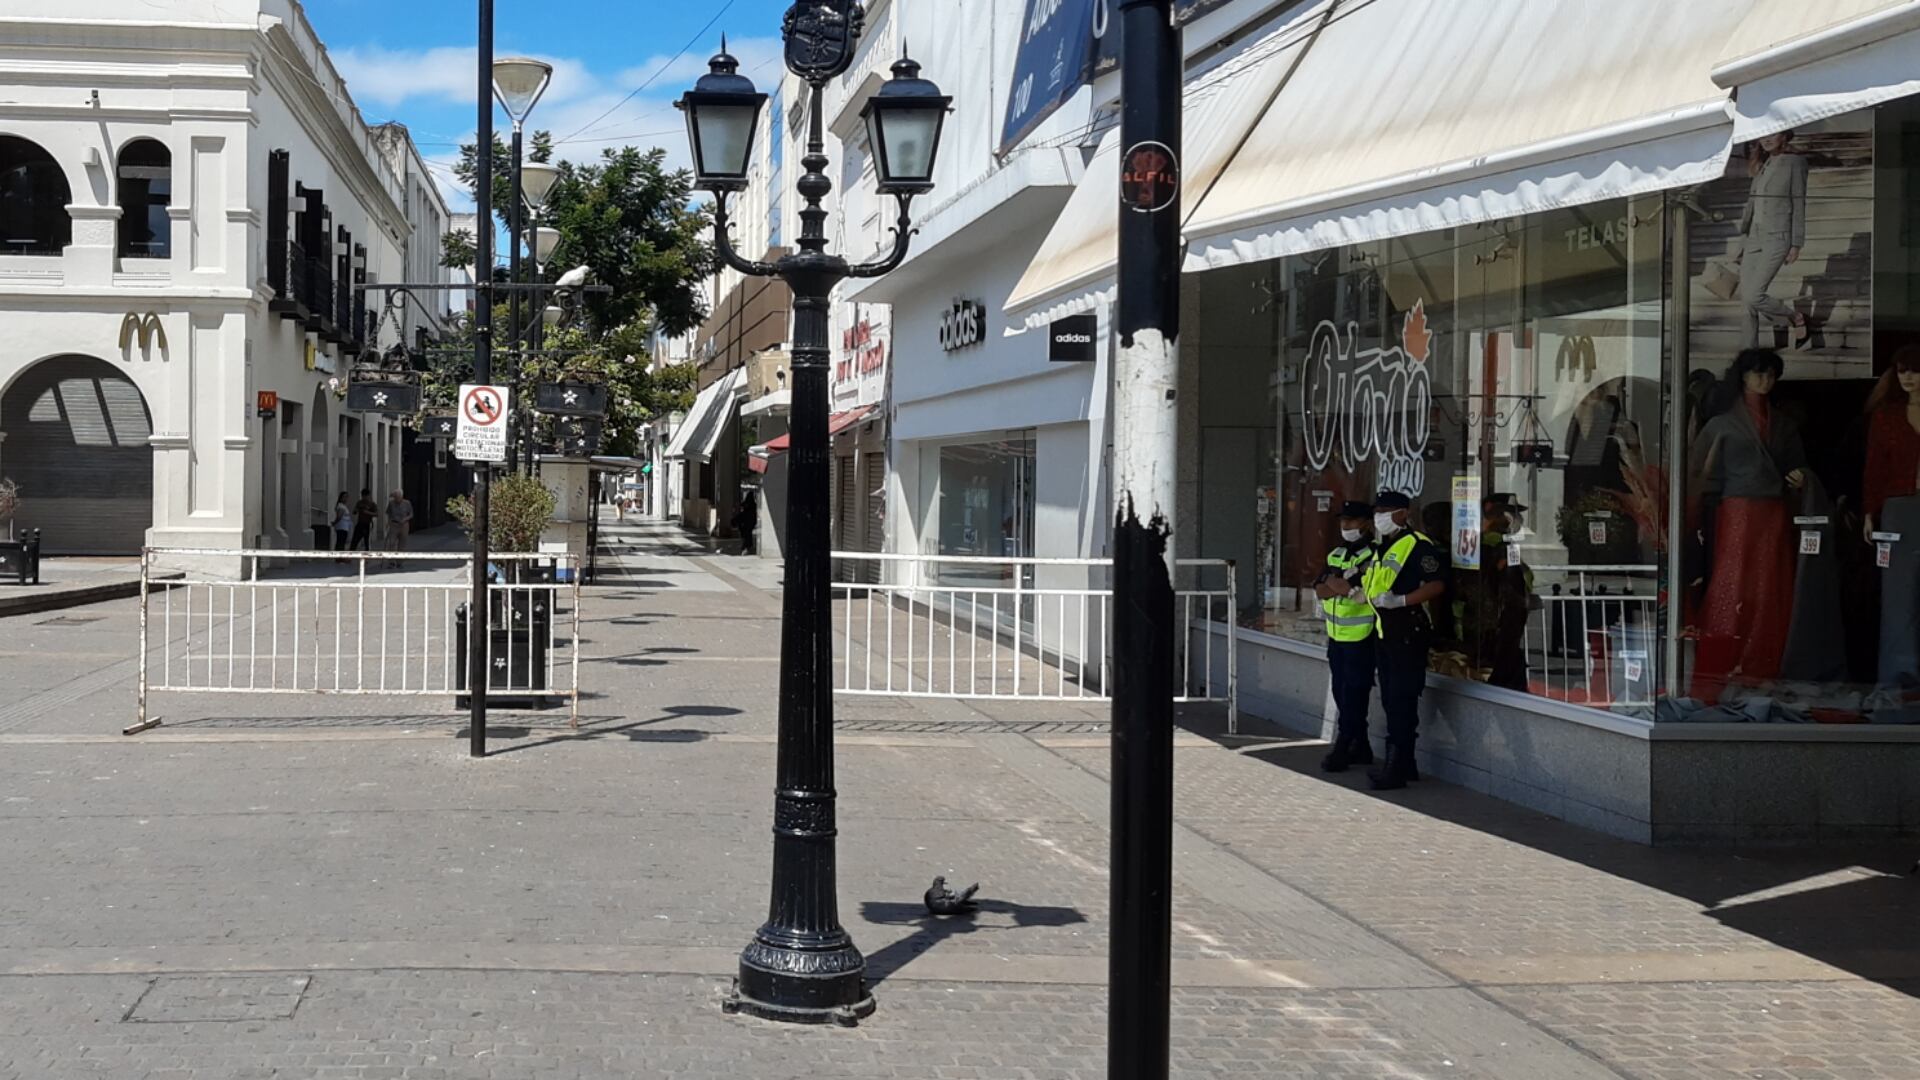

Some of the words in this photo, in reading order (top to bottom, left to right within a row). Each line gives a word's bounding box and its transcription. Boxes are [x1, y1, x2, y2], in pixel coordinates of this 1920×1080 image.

[1565, 216, 1628, 252] TELAS
[939, 300, 978, 351] adidas
[1055, 333, 1091, 343] adidas
[1376, 455, 1425, 499] 2020
